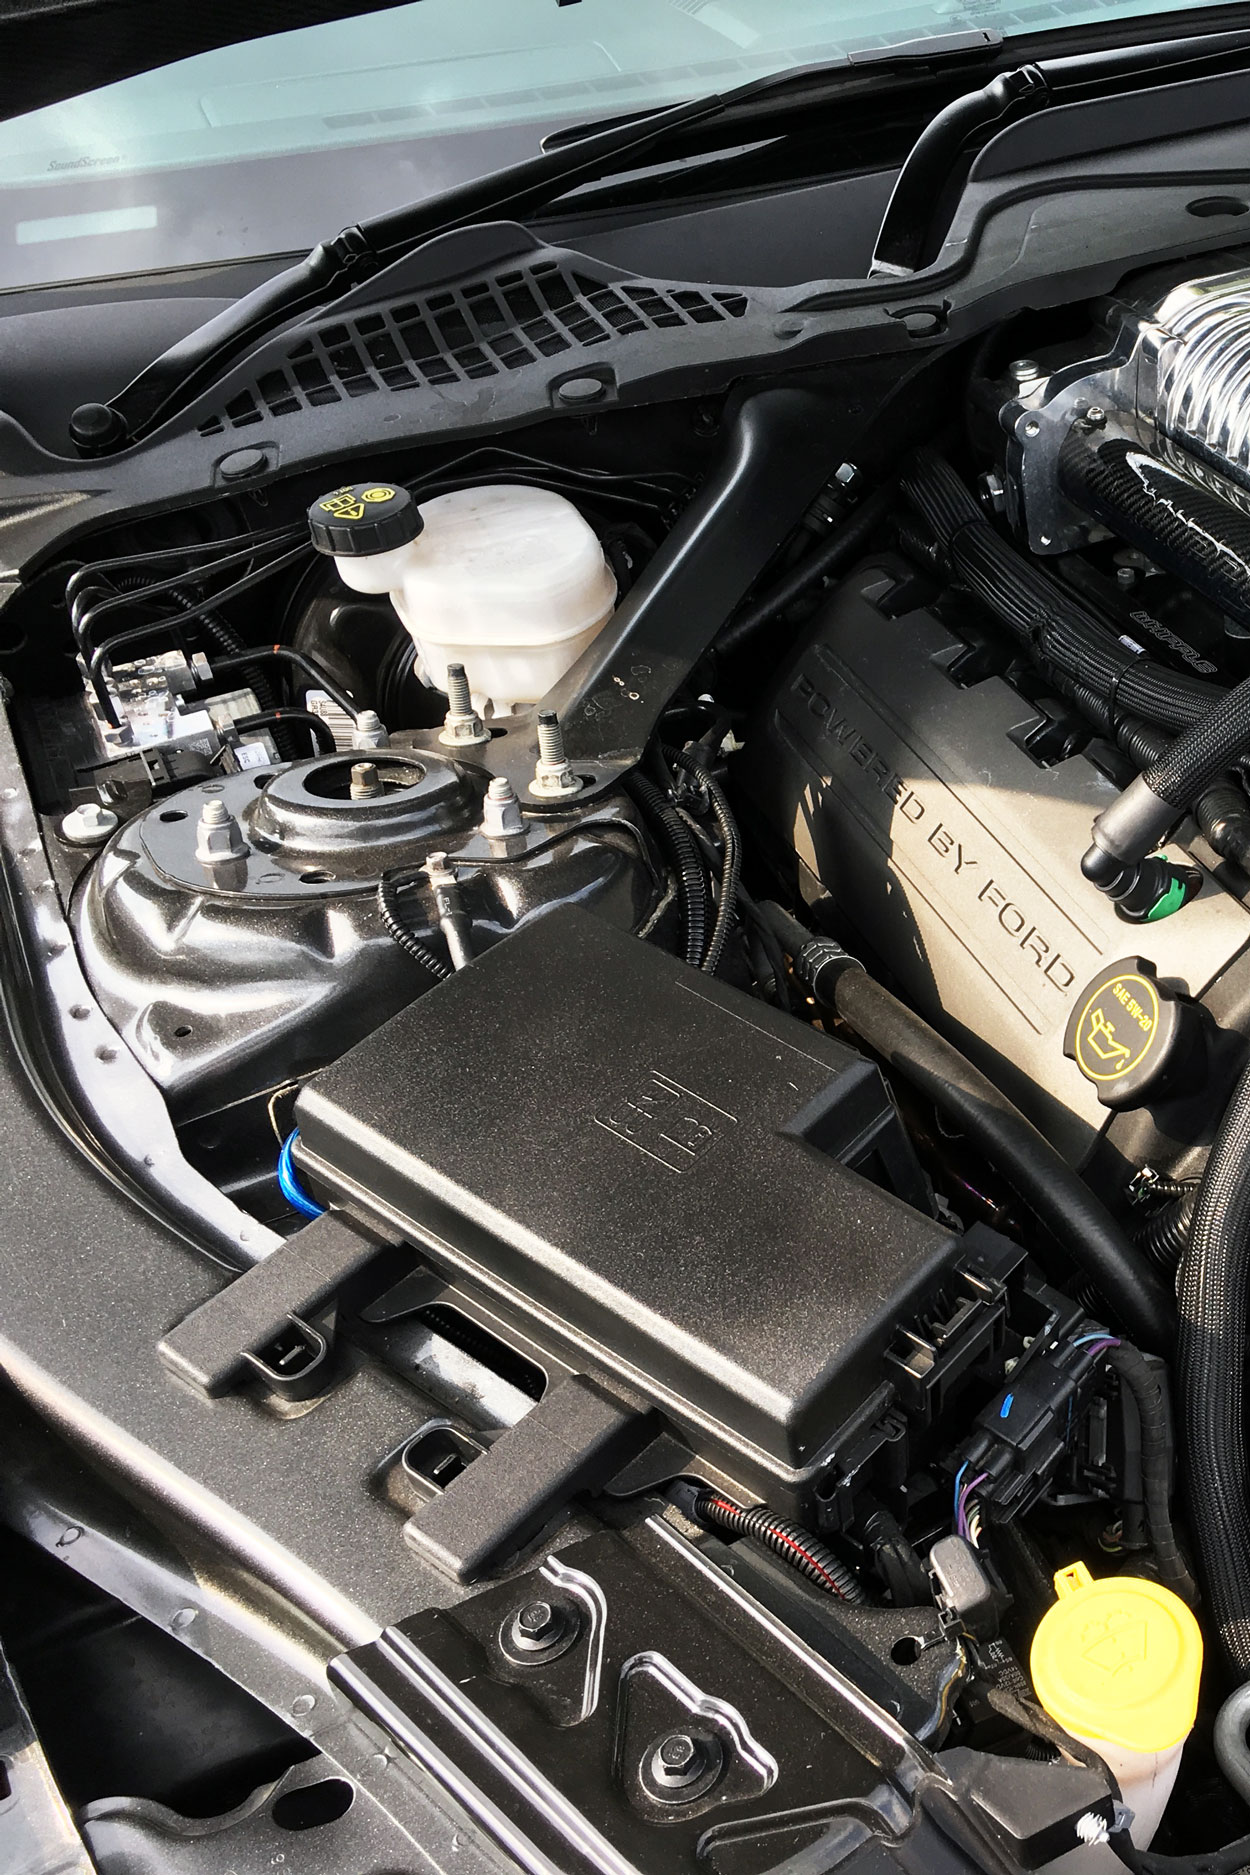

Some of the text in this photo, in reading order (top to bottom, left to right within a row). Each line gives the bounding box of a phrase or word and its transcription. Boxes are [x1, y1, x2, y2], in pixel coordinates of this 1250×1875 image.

[1130, 609, 1218, 674] WHIPPLE
[789, 673, 1076, 994] POWERED BY FORD
[1112, 982, 1153, 1032] SAE 5W-20
